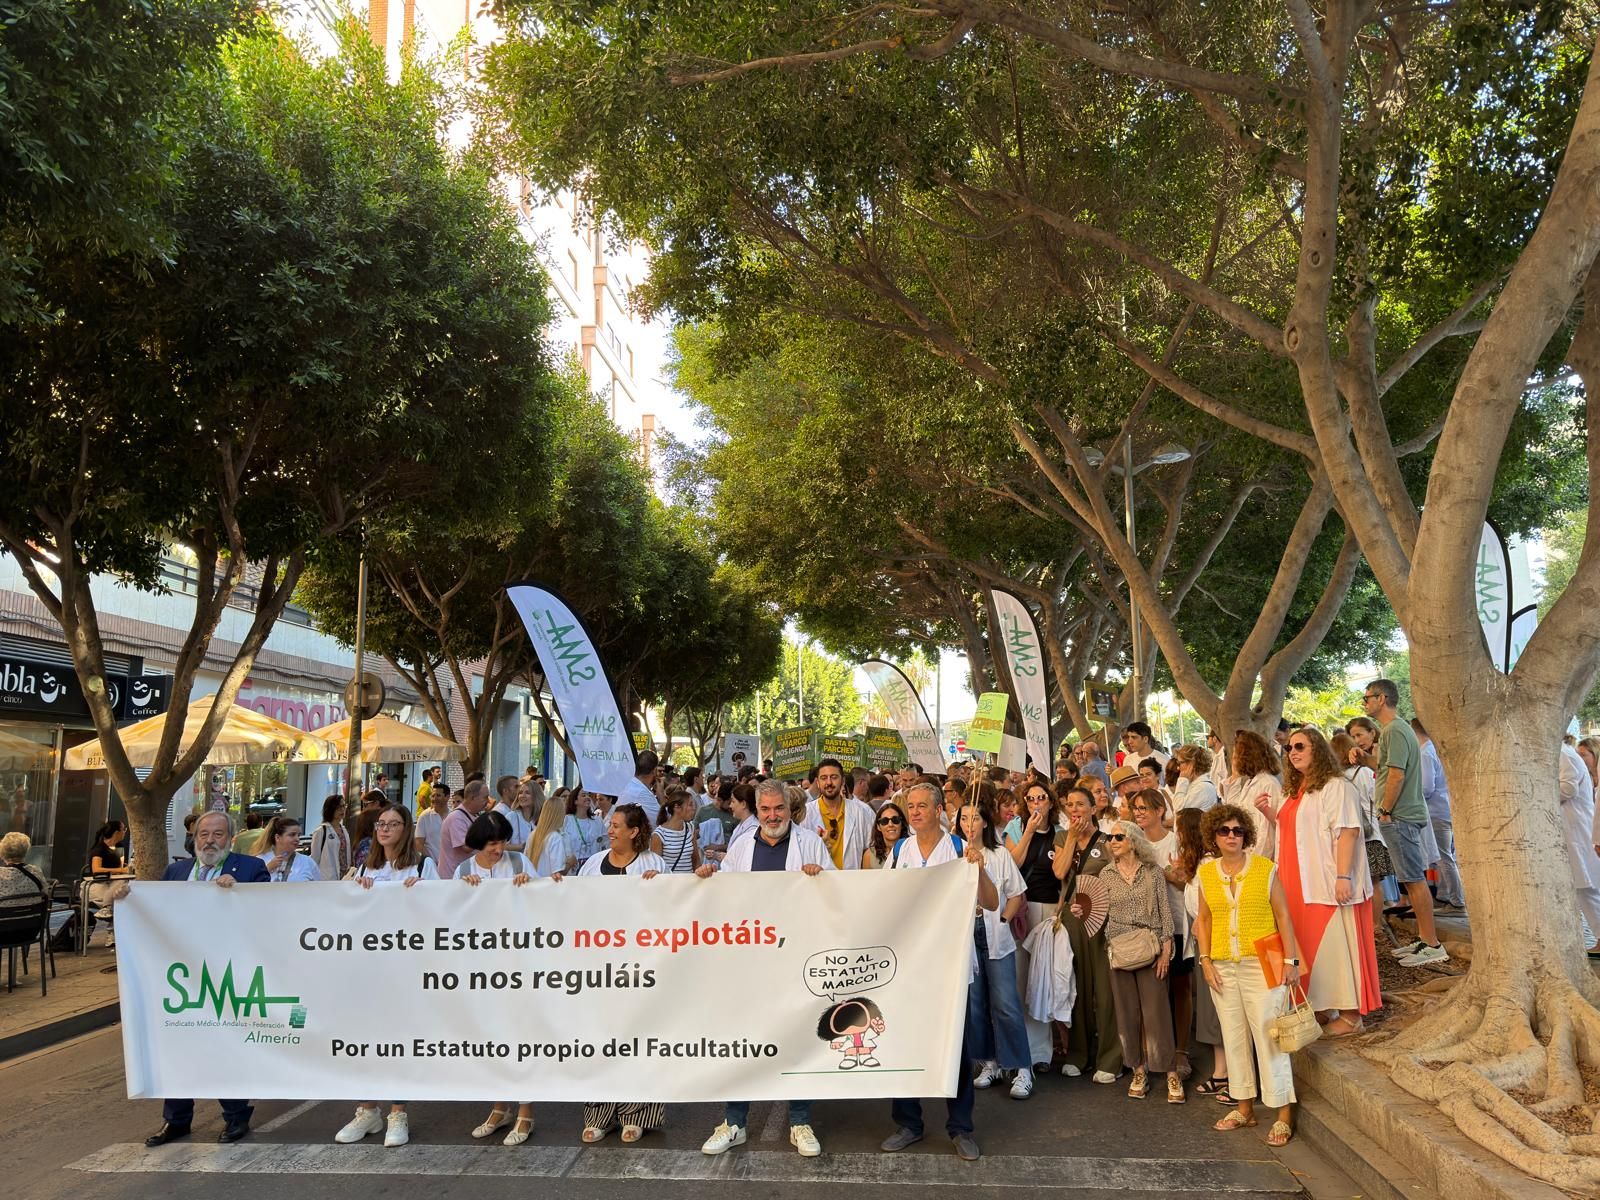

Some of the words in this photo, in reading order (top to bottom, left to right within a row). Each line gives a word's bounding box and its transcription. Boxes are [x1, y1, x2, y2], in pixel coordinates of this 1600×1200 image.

[784, 728, 813, 740] ESTATUTO
[782, 736, 808, 749] MARCO
[825, 738, 847, 747] BASTA
[272, 751, 307, 761] BLISS
[775, 749, 788, 758] NOS
[789, 744, 812, 754] IGNORA
[823, 745, 855, 754] PARCHES
[400, 753, 428, 761] BLISS
[299, 927, 353, 951] Con
[362, 929, 425, 951] este
[434, 926, 565, 951] Estatuto
[573, 928, 627, 948] nos
[635, 919, 786, 953] explotáis,
[825, 955, 848, 965] NO
[855, 954, 874, 964] AL
[809, 960, 890, 977] ESTATUTO
[423, 972, 459, 990] no
[469, 971, 523, 990] nos
[533, 962, 656, 995] reguláis
[162, 958, 300, 1021] SMA
[222, 1020, 248, 1028] Andaluz
[244, 1031, 301, 1045] Almería
[331, 1039, 369, 1057] Por
[376, 1043, 405, 1057] un
[412, 1038, 510, 1058] Estatuto
[517, 1038, 595, 1063] propio
[602, 1037, 639, 1058] del
[646, 1037, 779, 1058] Facultativo
